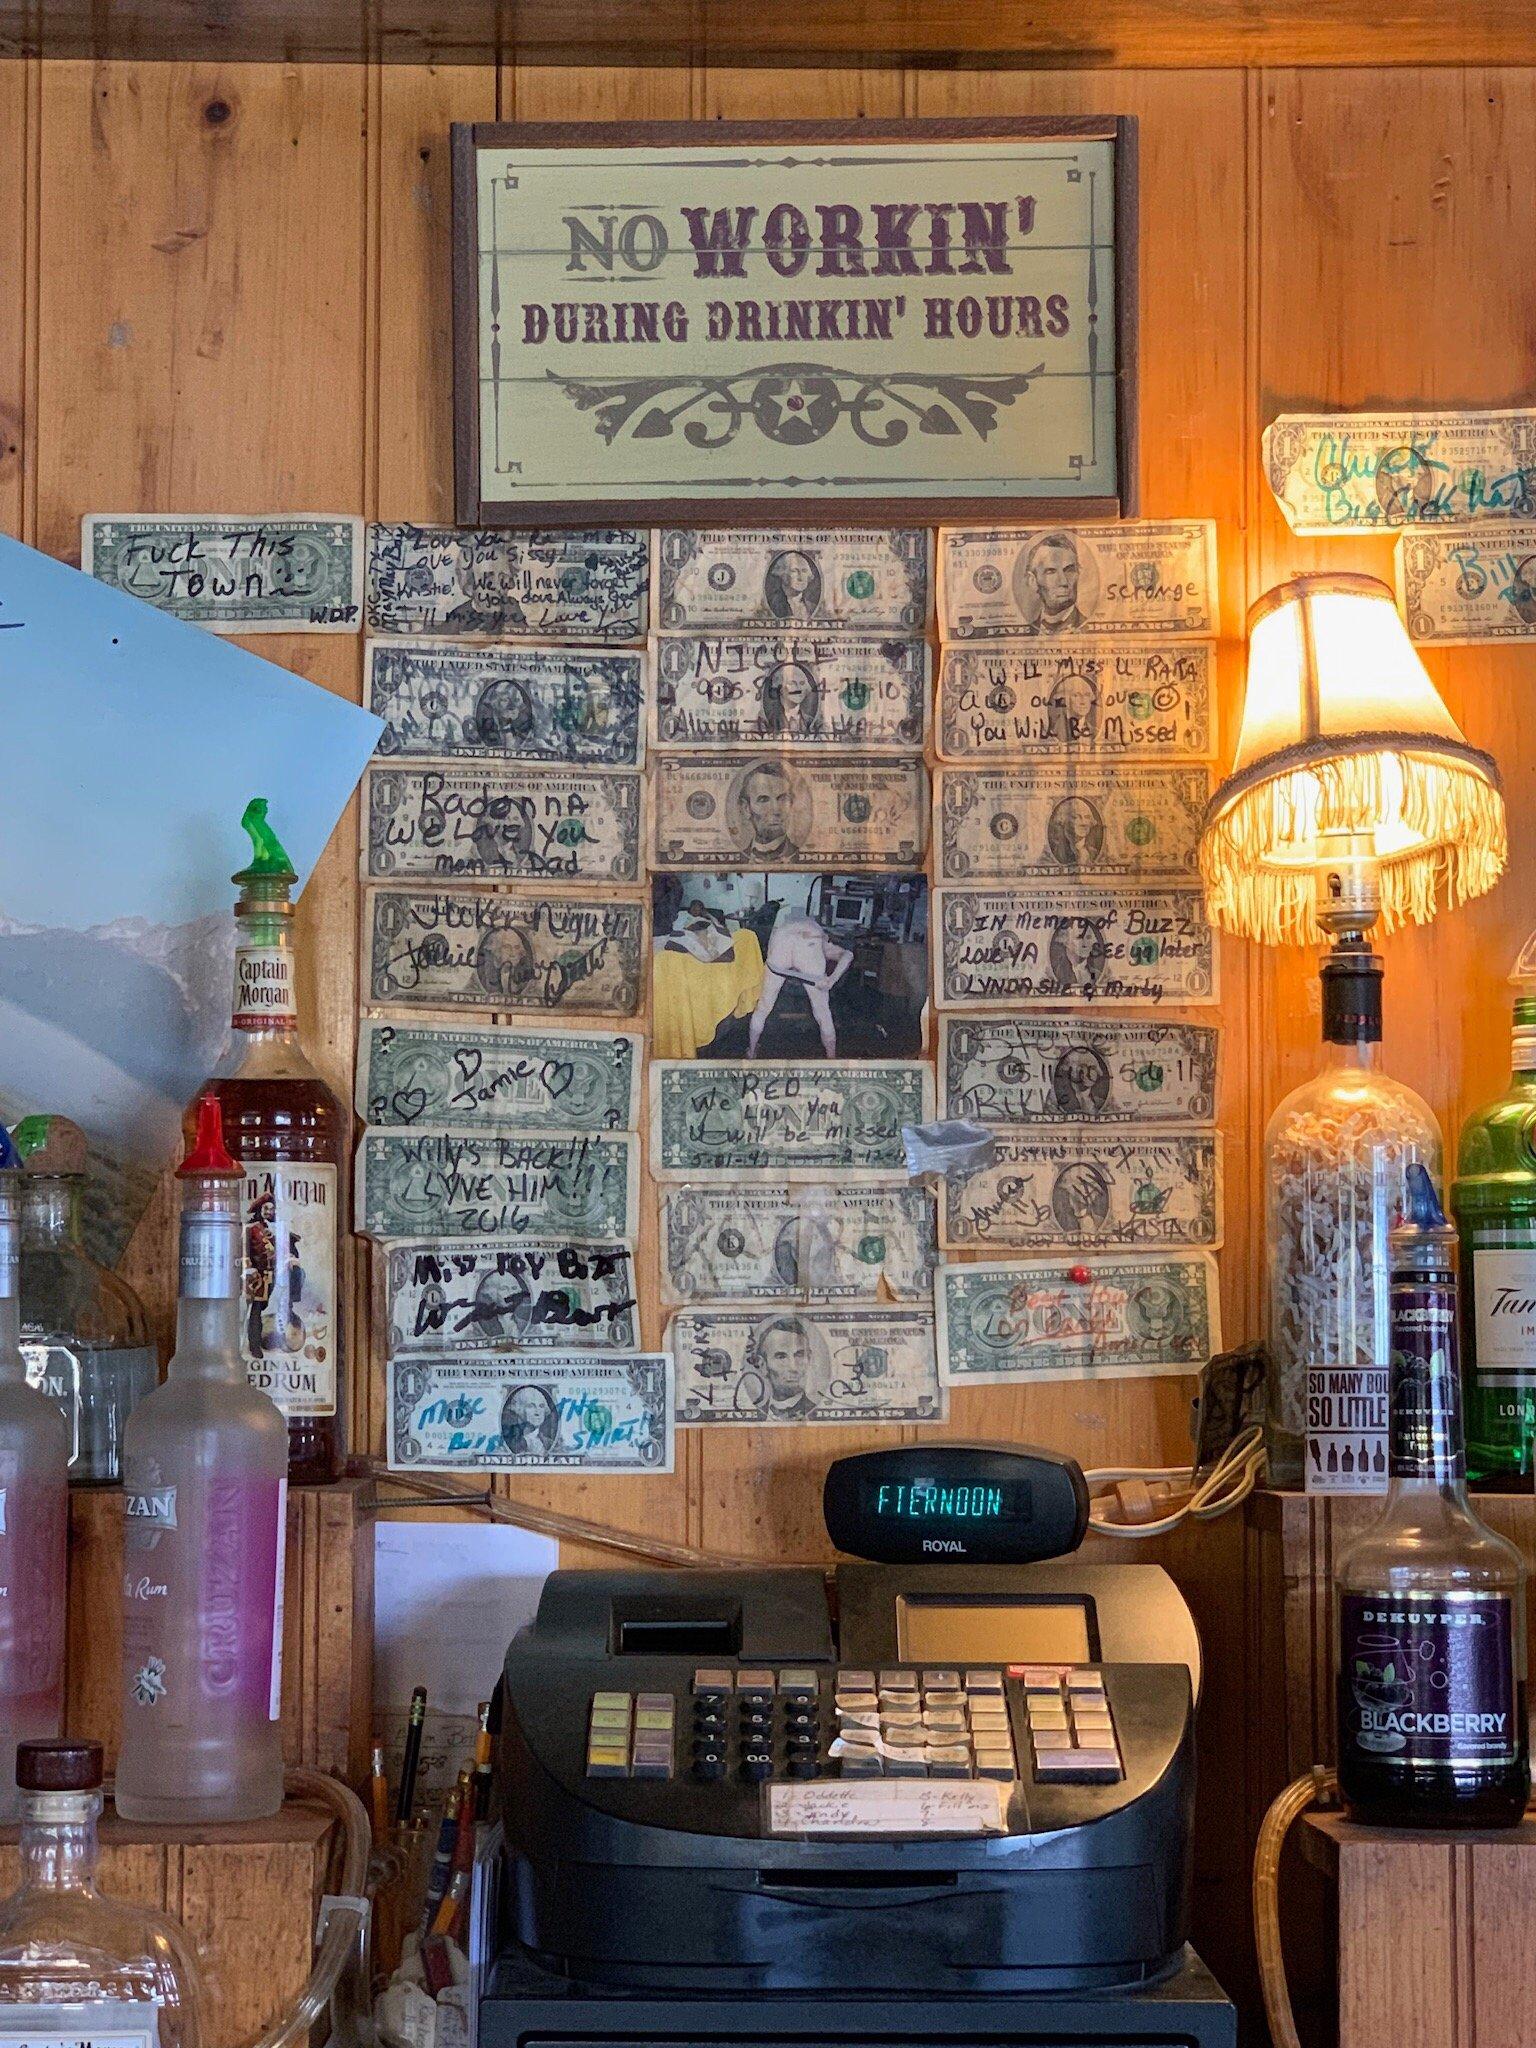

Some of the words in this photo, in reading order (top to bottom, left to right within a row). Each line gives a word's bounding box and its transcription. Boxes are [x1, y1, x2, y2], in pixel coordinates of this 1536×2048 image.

[562, 214, 669, 272] NO
[682, 196, 1036, 278] WORKIN'
[522, 301, 689, 344] DURING
[707, 295, 907, 342] DRINKIN'
[924, 294, 1069, 339] HOURS
[1311, 432, 1331, 440] THE
[1334, 431, 1379, 440] UNITED
[1444, 430, 1496, 438] AMERICA
[129, 524, 154, 532] THE
[154, 524, 200, 532] UNITED
[126, 532, 206, 566] Fuck
[222, 528, 296, 559] This
[702, 534, 726, 544] THE
[728, 534, 770, 544] UNITED
[772, 534, 812, 543] STATES
[816, 534, 831, 543] OF
[833, 534, 884, 543] AMERICA
[160, 569, 264, 597] Town
[987, 627, 1031, 635] FIVE
[1087, 622, 1175, 631] DOLLARS
[695, 640, 838, 677] NICOLE
[543, 783, 597, 792] AMERICA
[983, 781, 1006, 789] THE
[1009, 780, 1051, 789] UNITED
[1054, 780, 1095, 788] STATES
[1097, 780, 1113, 788] OF
[1115, 780, 1166, 788] AMERICA
[538, 820, 600, 856] You
[984, 901, 1009, 910] THE
[1010, 901, 1053, 910] UNITED
[1056, 901, 1096, 909] STATES
[1100, 900, 1117, 908] OF
[1118, 900, 1168, 909] AMERICA
[972, 915, 1007, 932] IN
[239, 958, 288, 985] Captain
[238, 985, 289, 1010] Morgan
[407, 1032, 431, 1040] THE
[433, 1032, 480, 1042] UNITED
[481, 1035, 525, 1045] STATES
[527, 1038, 544, 1046] OF
[544, 1038, 599, 1050] AMERICA
[709, 1200, 735, 1209] THE
[737, 1200, 780, 1209] UNITED
[842, 1199, 895, 1208] AMERICA
[457, 1205, 530, 1234] 2016
[981, 1274, 1007, 1282] THE
[1008, 1272, 1052, 1281] UNITED
[1101, 1268, 1116, 1276] OF
[1116, 1266, 1171, 1276] AMERICA
[436, 1369, 459, 1378] THE
[462, 1369, 506, 1378] UNITED
[508, 1369, 550, 1378] STATES
[553, 1369, 570, 1378] OF
[571, 1369, 622, 1378] AMERICA
[1310, 1373, 1324, 1393] SO
[1329, 1373, 1363, 1393] MANY
[715, 1411, 758, 1419] FIVE
[816, 1409, 905, 1417] DOLLARS
[1309, 1397, 1332, 1427] SO
[1339, 1397, 1386, 1427] LITTLE
[480, 1456, 513, 1465] ONE
[515, 1456, 582, 1465] DOLLAR
[923, 1540, 966, 1552] ROYAL
[1361, 1711, 1507, 1733] BLACKBERRY
[706, 1754, 717, 1762] 0
[747, 1754, 770, 1763] 00
